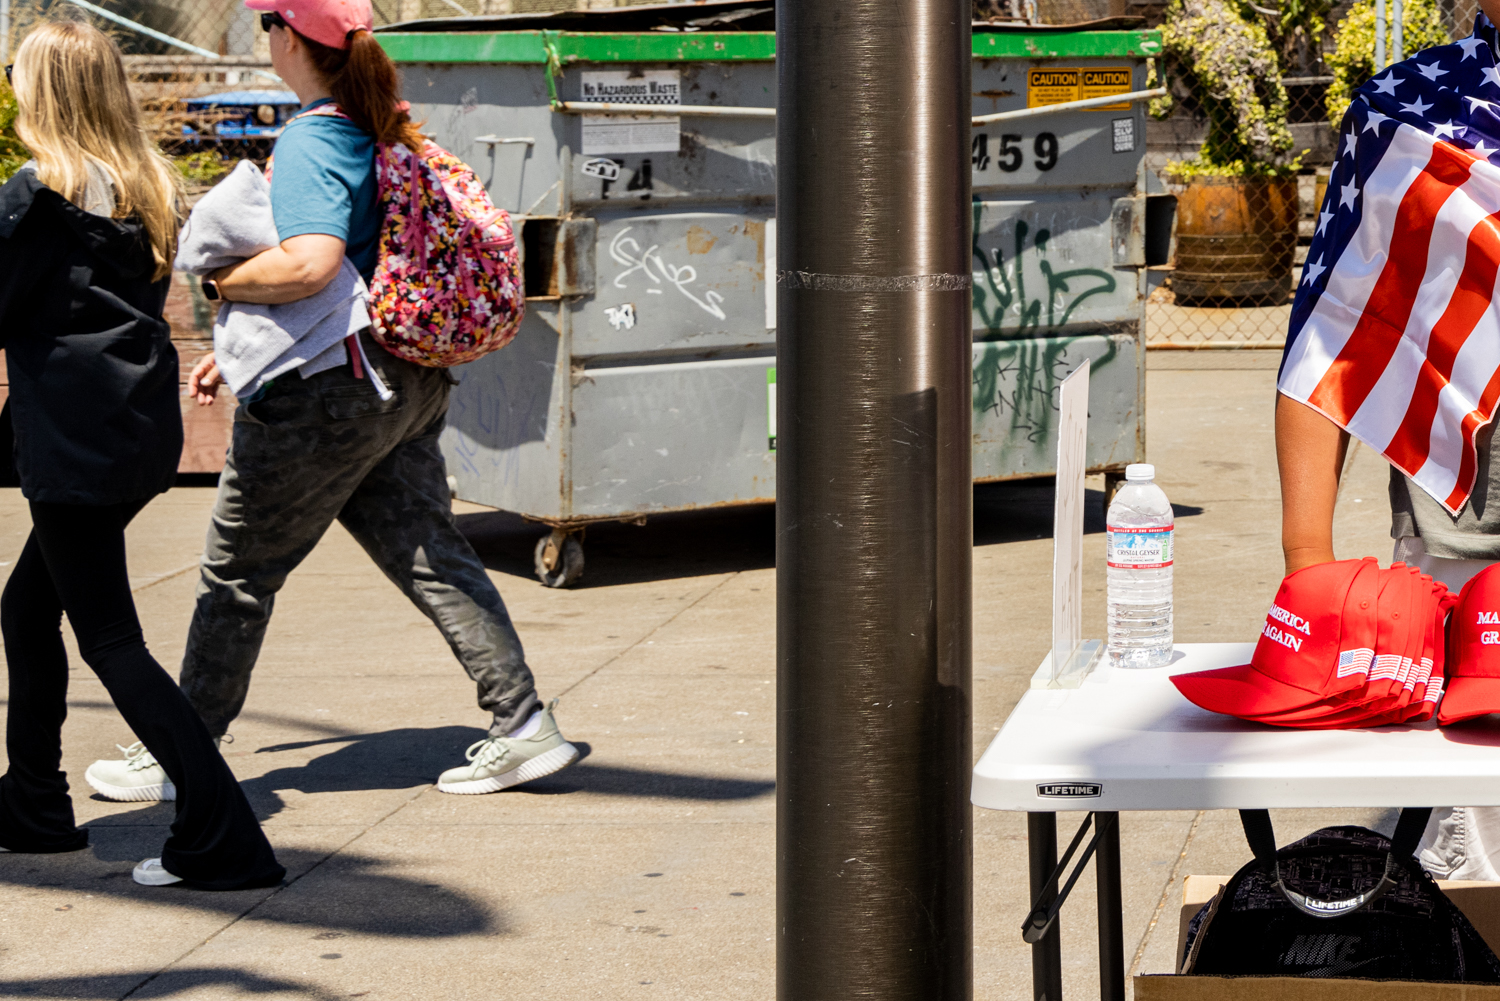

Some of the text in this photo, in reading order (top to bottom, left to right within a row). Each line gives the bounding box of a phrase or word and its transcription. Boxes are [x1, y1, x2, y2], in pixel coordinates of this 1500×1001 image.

[1032, 74, 1076, 85] CAUTION
[1085, 73, 1128, 85] CAUTION
[1264, 624, 1303, 652] AGAIN
[1045, 786, 1093, 794] LIFETIME
[1311, 898, 1357, 909] LIFETIME
[1284, 934, 1361, 965] NIKE
